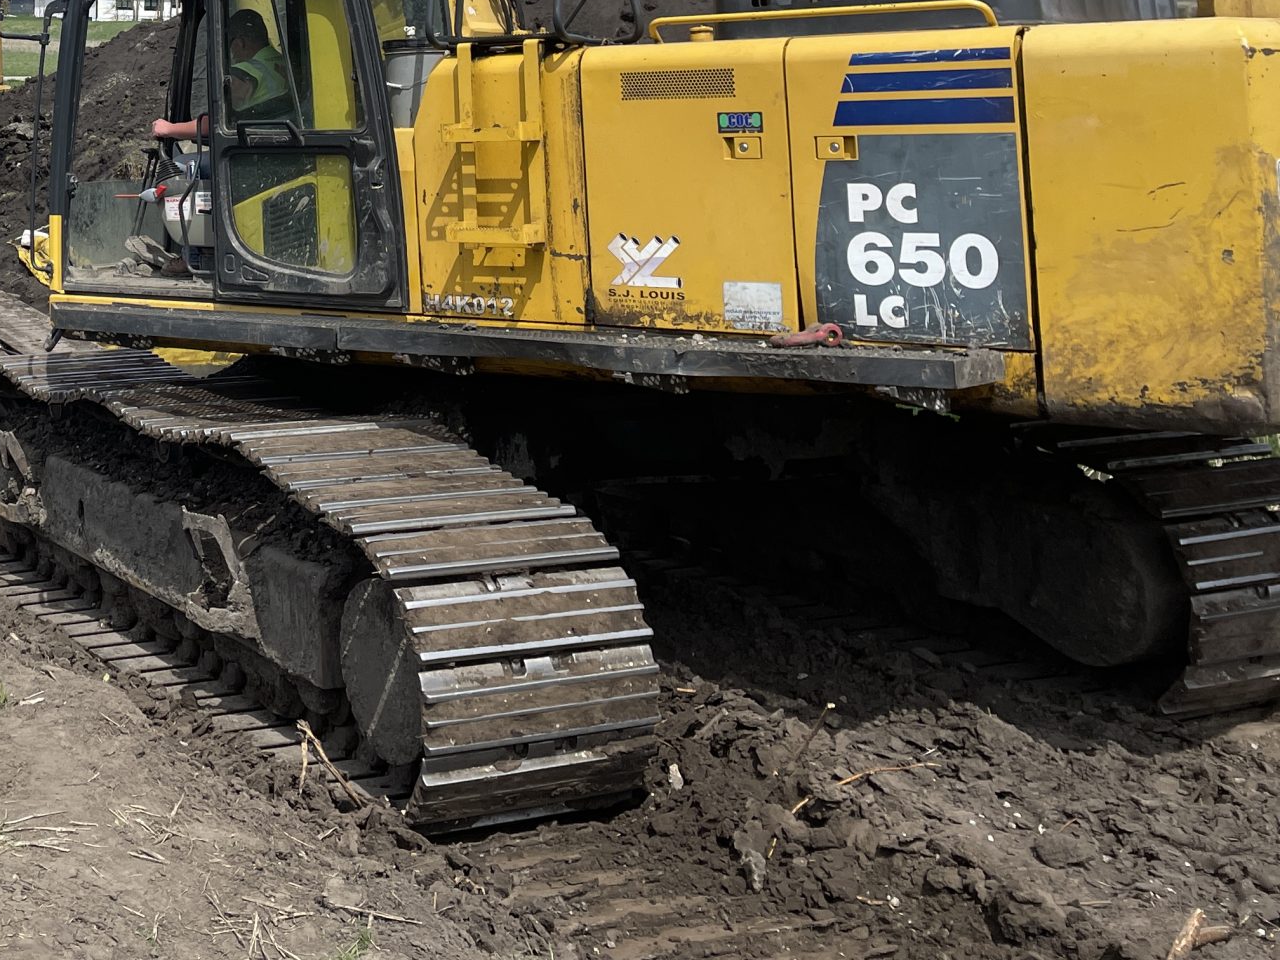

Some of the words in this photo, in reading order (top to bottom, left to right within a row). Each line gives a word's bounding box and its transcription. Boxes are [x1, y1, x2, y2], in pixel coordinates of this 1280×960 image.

[847, 182, 919, 224] PC
[846, 231, 999, 290] 650
[423, 294, 515, 316] H4K012
[608, 288, 635, 298] S.J.
[640, 290, 686, 301] LOUIS
[853, 293, 910, 329] LC
